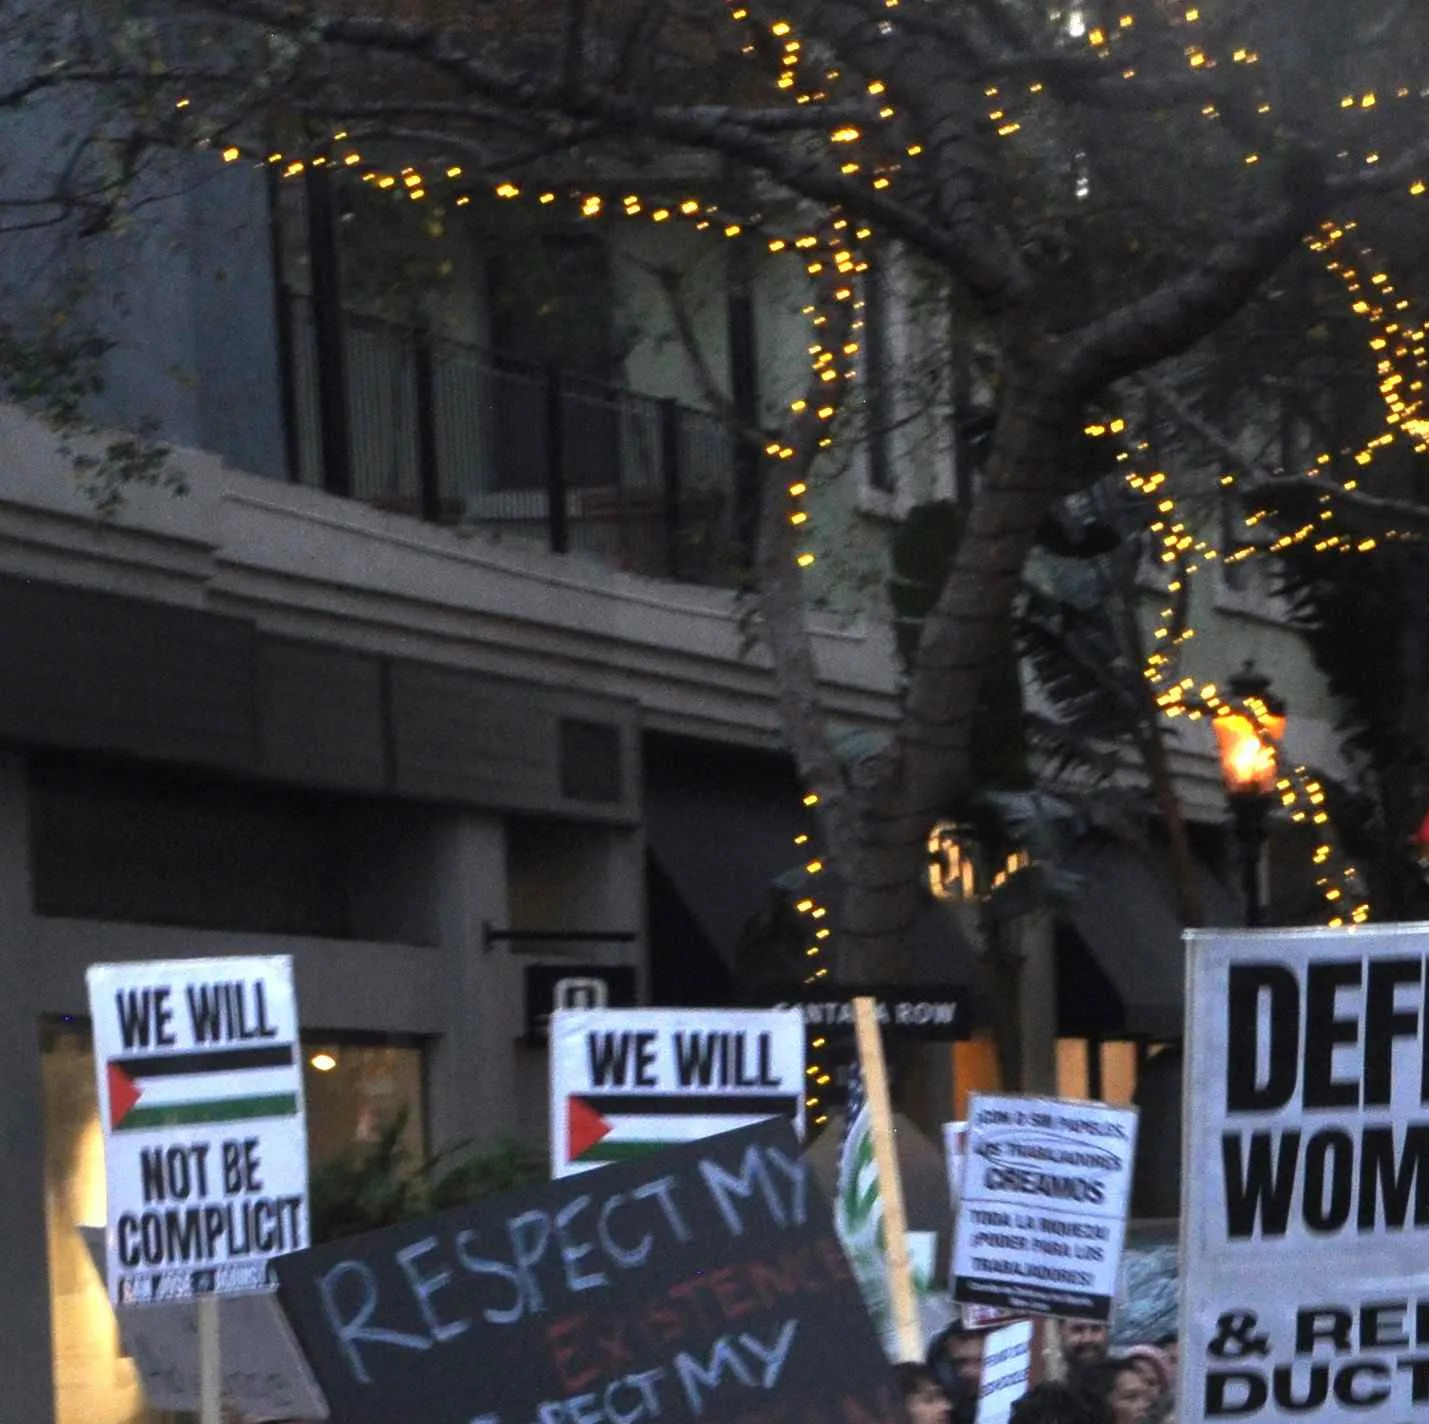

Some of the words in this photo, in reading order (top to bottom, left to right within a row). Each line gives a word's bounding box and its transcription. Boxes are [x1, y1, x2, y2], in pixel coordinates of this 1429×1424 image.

[115, 985, 176, 1048] WE
[186, 978, 278, 1043] WILL
[588, 1030, 659, 1088] WE
[673, 1030, 781, 1087] WILL
[140, 1142, 211, 1203] NOT
[222, 1137, 263, 1193] BE
[117, 1196, 303, 1267] COMPLICIT
[318, 1176, 692, 1384] RESPECT
[699, 1143, 813, 1236] MY
[675, 1319, 799, 1416] MY
[1207, 1308, 1272, 1359] &
